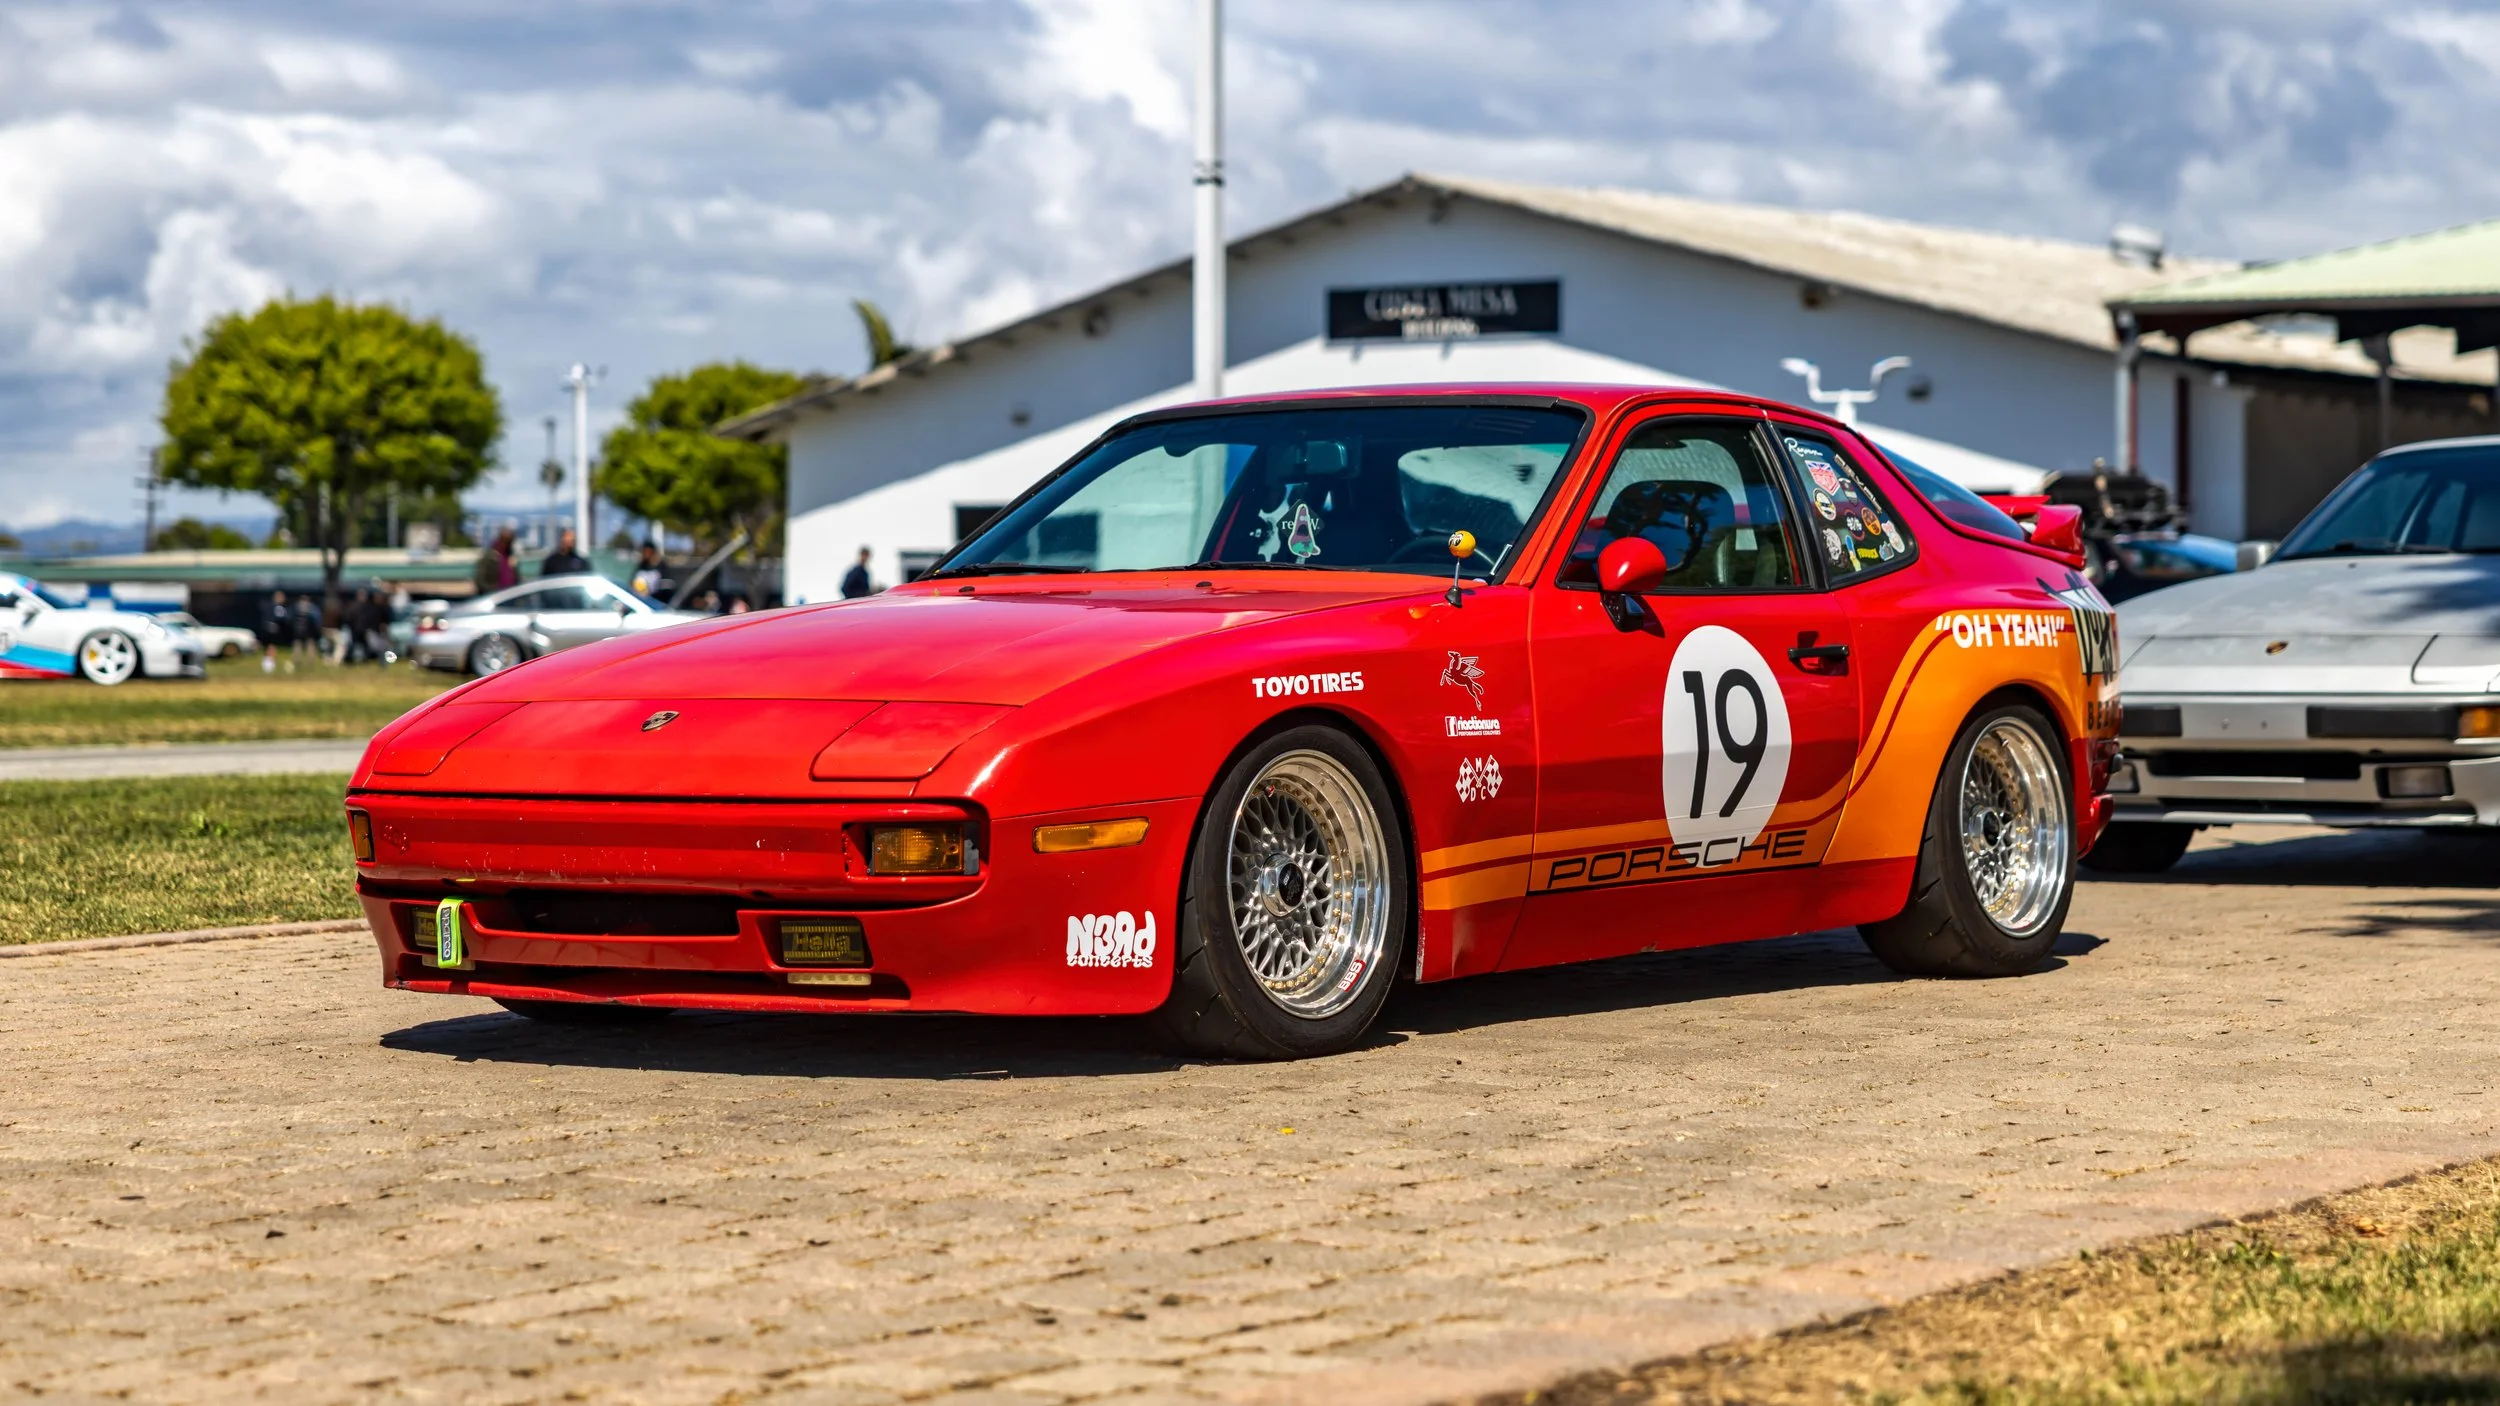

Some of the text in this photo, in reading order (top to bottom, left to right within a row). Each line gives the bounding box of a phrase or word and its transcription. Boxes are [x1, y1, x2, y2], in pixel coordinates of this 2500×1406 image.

[1252, 671, 1365, 698] TOYO TIRES
[1682, 668, 1768, 819] 19
[1547, 829, 1807, 889] PORSCHE
[1337, 961, 1363, 991] BBS
